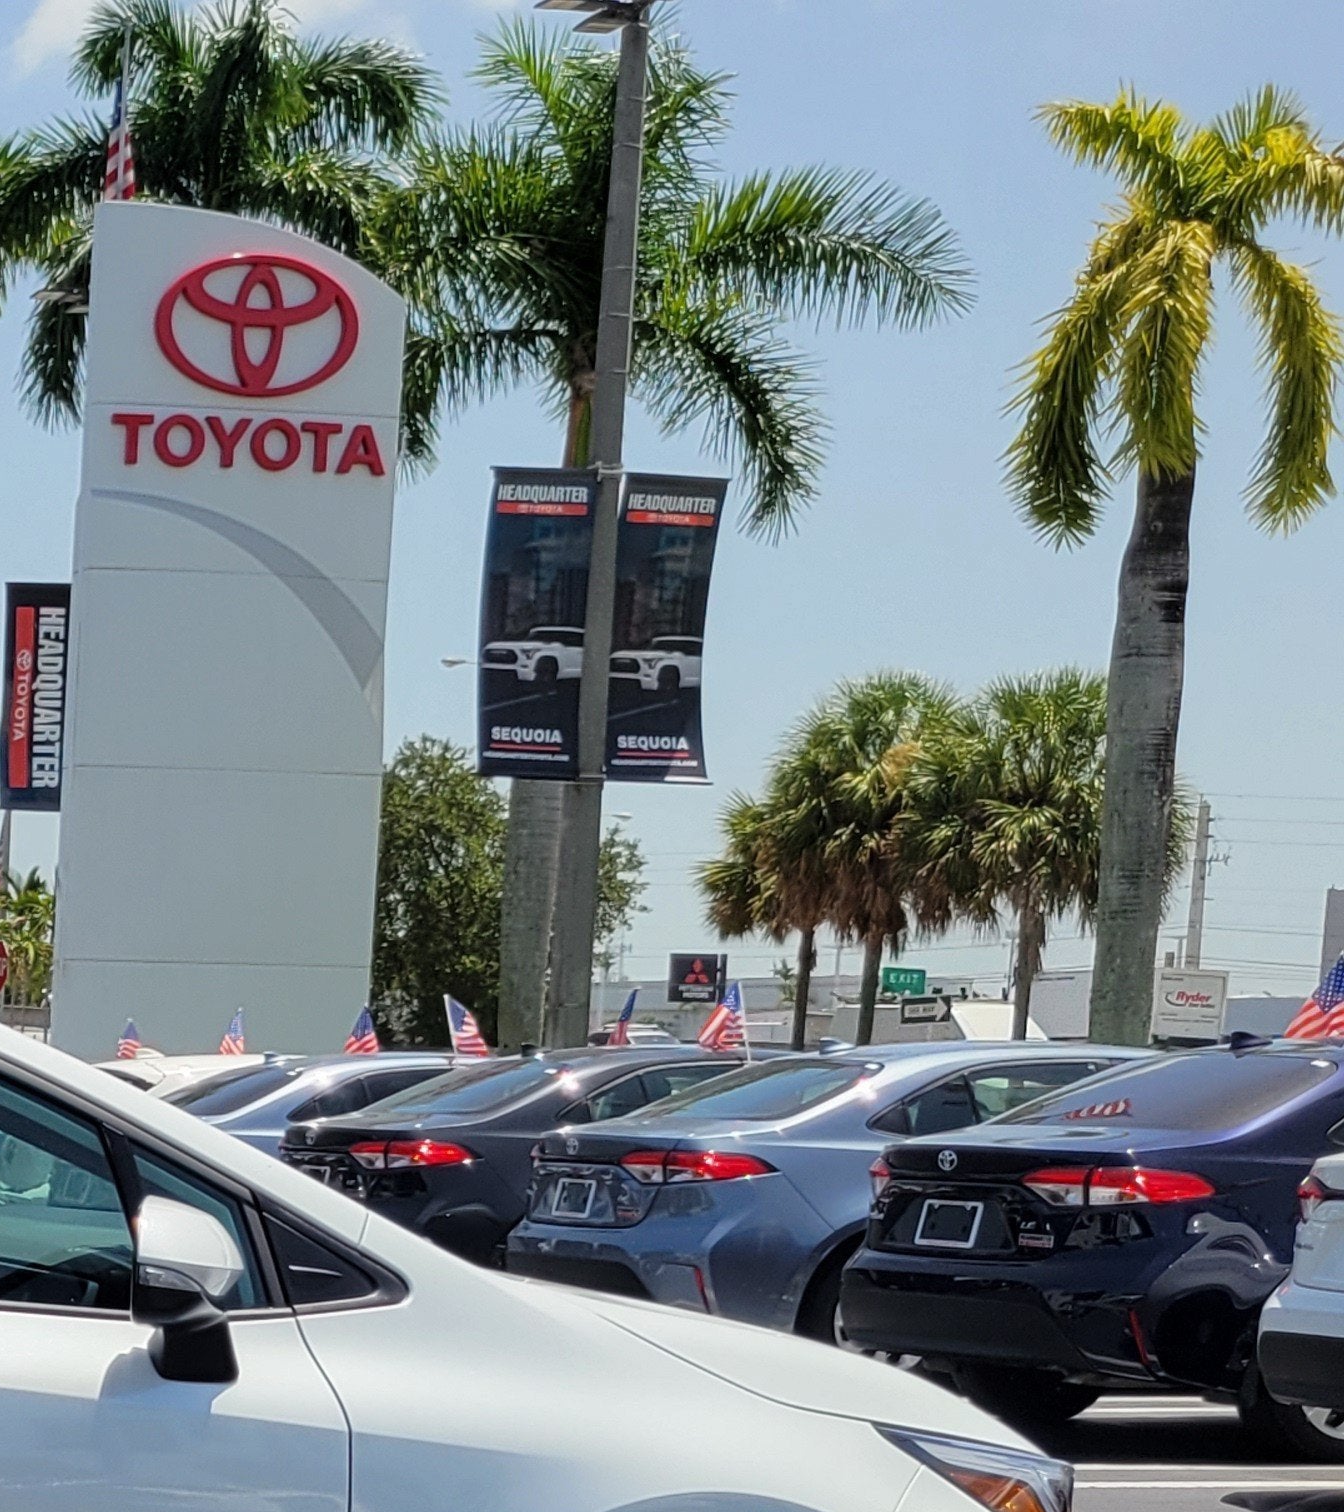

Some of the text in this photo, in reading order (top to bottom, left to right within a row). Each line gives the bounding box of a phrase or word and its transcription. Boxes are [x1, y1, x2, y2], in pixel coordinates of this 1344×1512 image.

[111, 413, 385, 477] TOYOTA
[497, 484, 589, 503] HEADQUARTER
[628, 493, 716, 514] HEADQUARTER
[12, 672, 29, 741] TOYOTA
[31, 606, 66, 788] HEADQUARTER
[491, 726, 562, 744] SEQUOIA
[617, 735, 689, 751] SEQUOIA
[889, 972, 919, 984] EXIT
[1175, 990, 1212, 1005] Ryder
